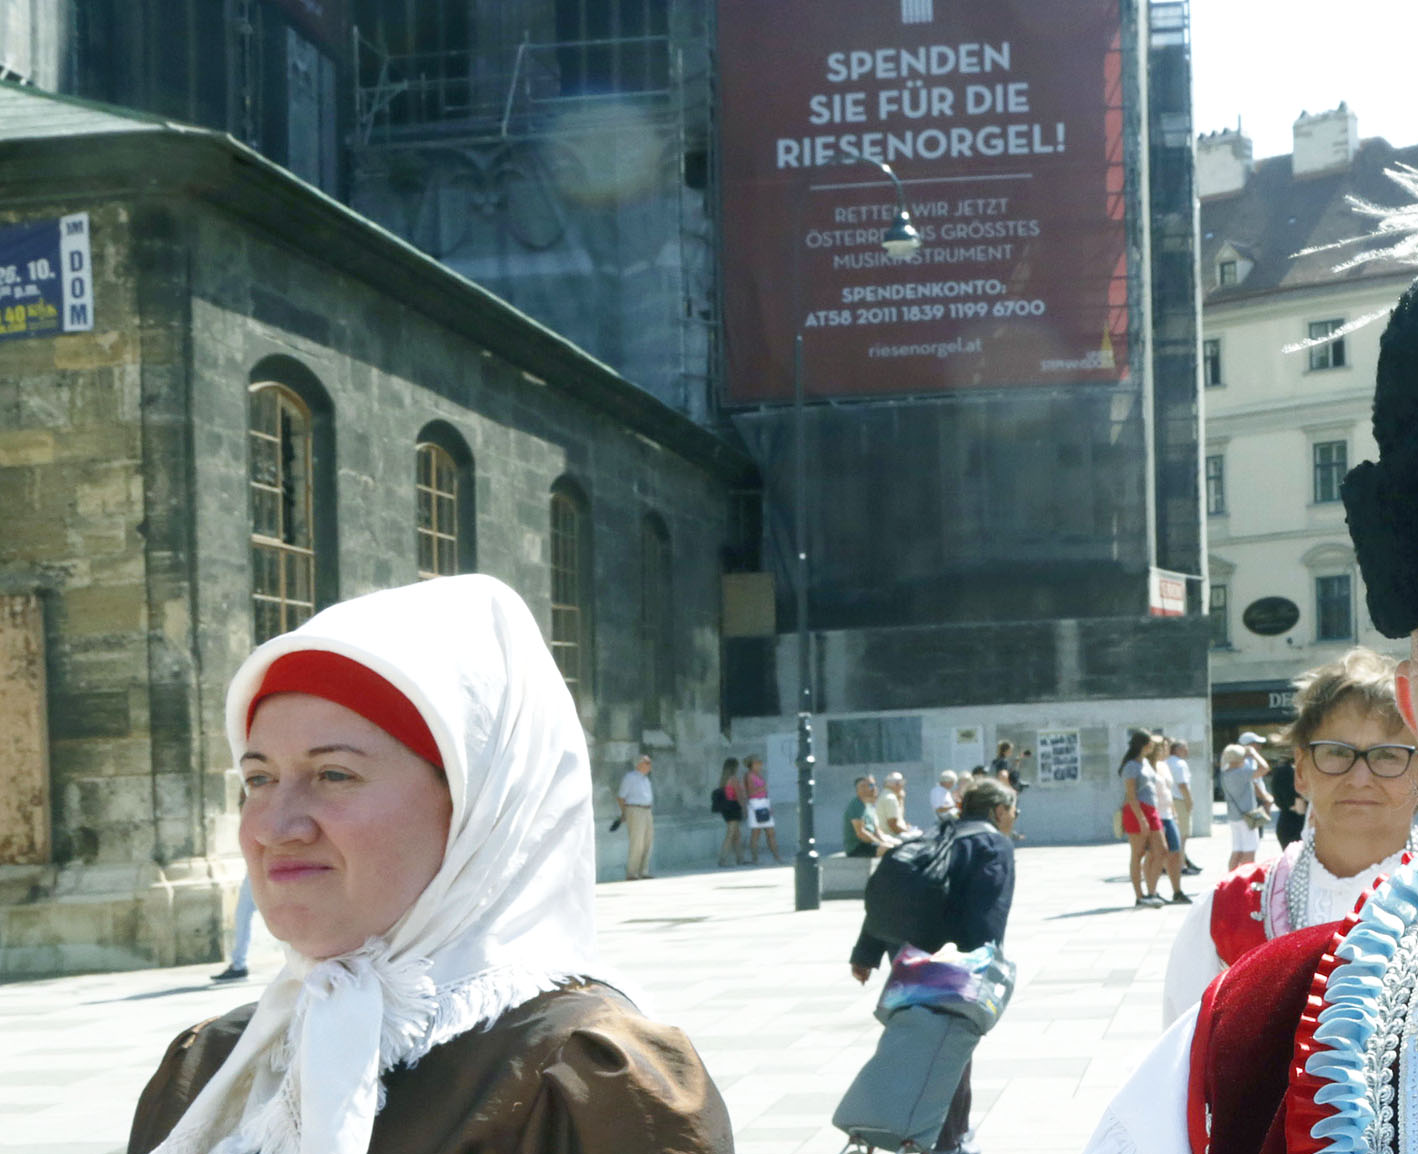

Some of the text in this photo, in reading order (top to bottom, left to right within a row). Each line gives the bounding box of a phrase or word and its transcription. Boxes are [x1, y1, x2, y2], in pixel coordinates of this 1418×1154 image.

[826, 41, 1010, 82] SPENDEN
[808, 79, 1030, 124] SIE FÜR DIE
[776, 122, 1065, 169] RIESENORGEL!
[911, 200, 948, 218] WIR
[953, 198, 1008, 217] JETZT
[940, 219, 1041, 240] GRÖSSTES
[842, 279, 1008, 303] SPENDENKONTO:
[805, 299, 1045, 328] AT58 2011 1839 1199 6700
[868, 337, 983, 358] riesenorgel.at
